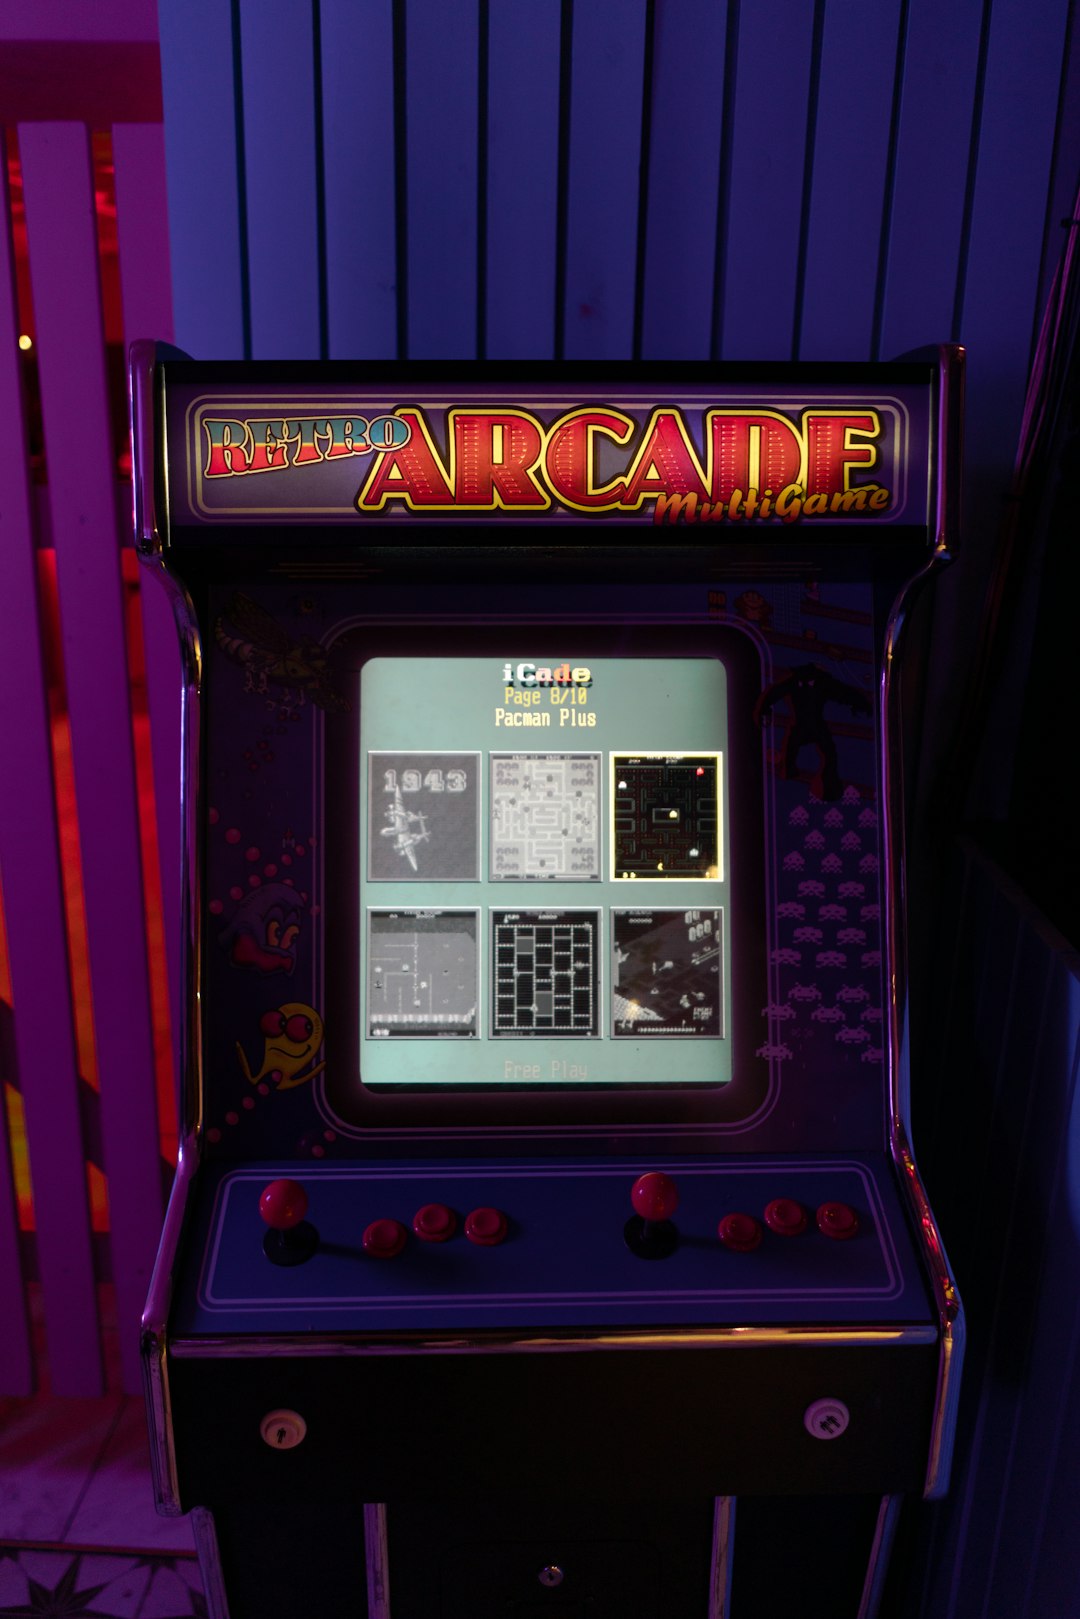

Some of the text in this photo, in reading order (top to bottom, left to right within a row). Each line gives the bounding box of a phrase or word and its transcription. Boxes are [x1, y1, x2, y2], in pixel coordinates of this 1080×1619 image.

[203, 406, 881, 512] RETRO ARCADE
[653, 482, 890, 526] MultiGame
[502, 663, 592, 688] iCade
[505, 687, 587, 707] Page 8/10
[495, 708, 597, 726] Pacman Plus
[384, 769, 467, 791] 1943
[504, 1060, 588, 1081] Free Play
